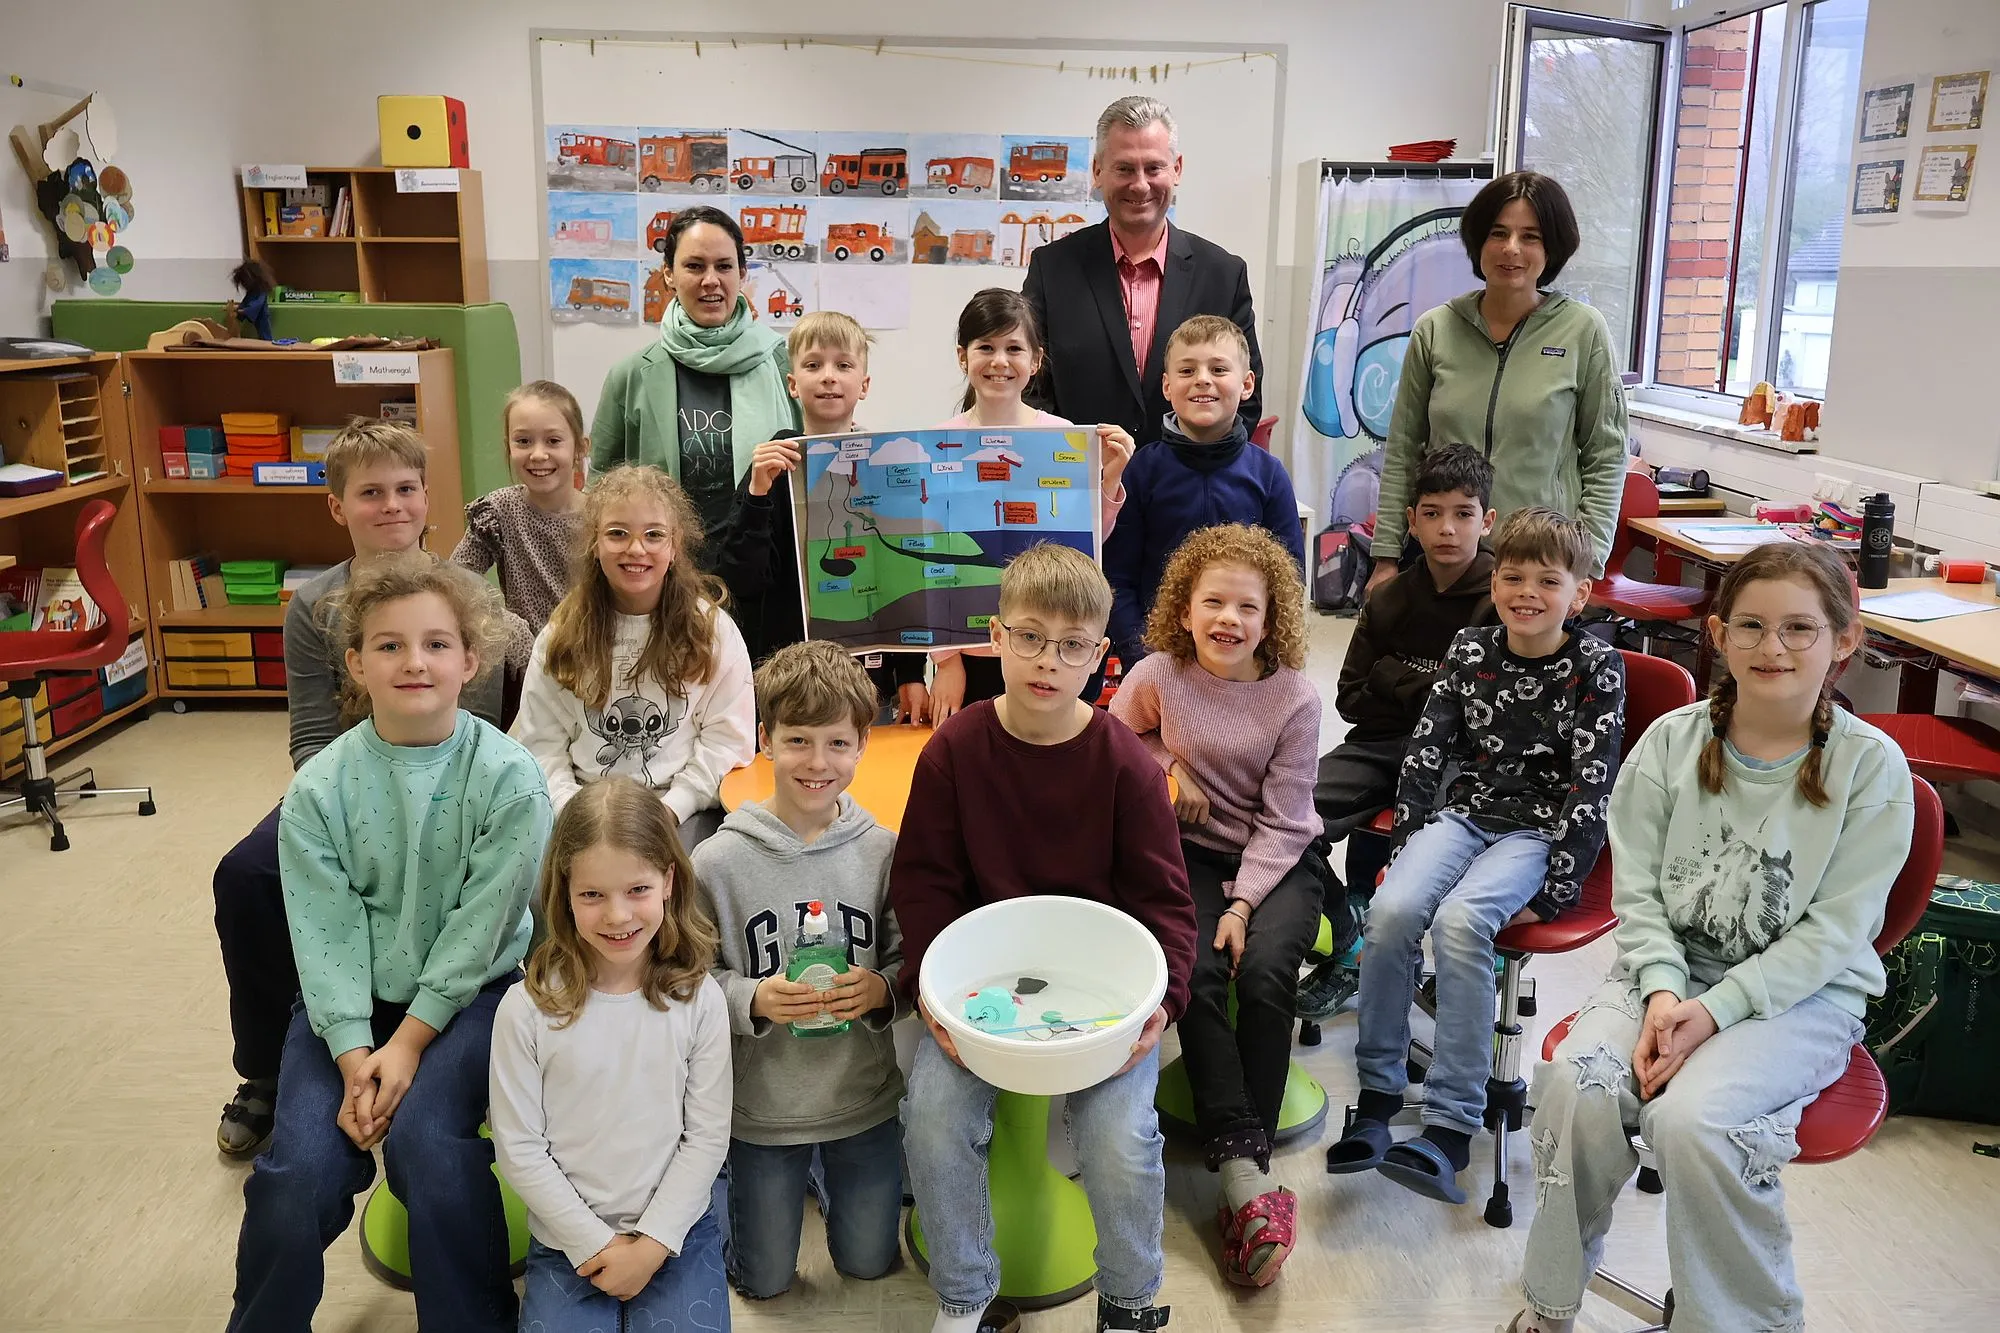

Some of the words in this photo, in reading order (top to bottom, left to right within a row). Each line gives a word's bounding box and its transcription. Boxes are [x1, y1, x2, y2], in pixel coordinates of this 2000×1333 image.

[369, 366, 412, 376] Matheregal
[1872, 534, 1889, 543] SG
[1673, 856, 1687, 865] KEEP
[1667, 863, 1680, 872] AND
